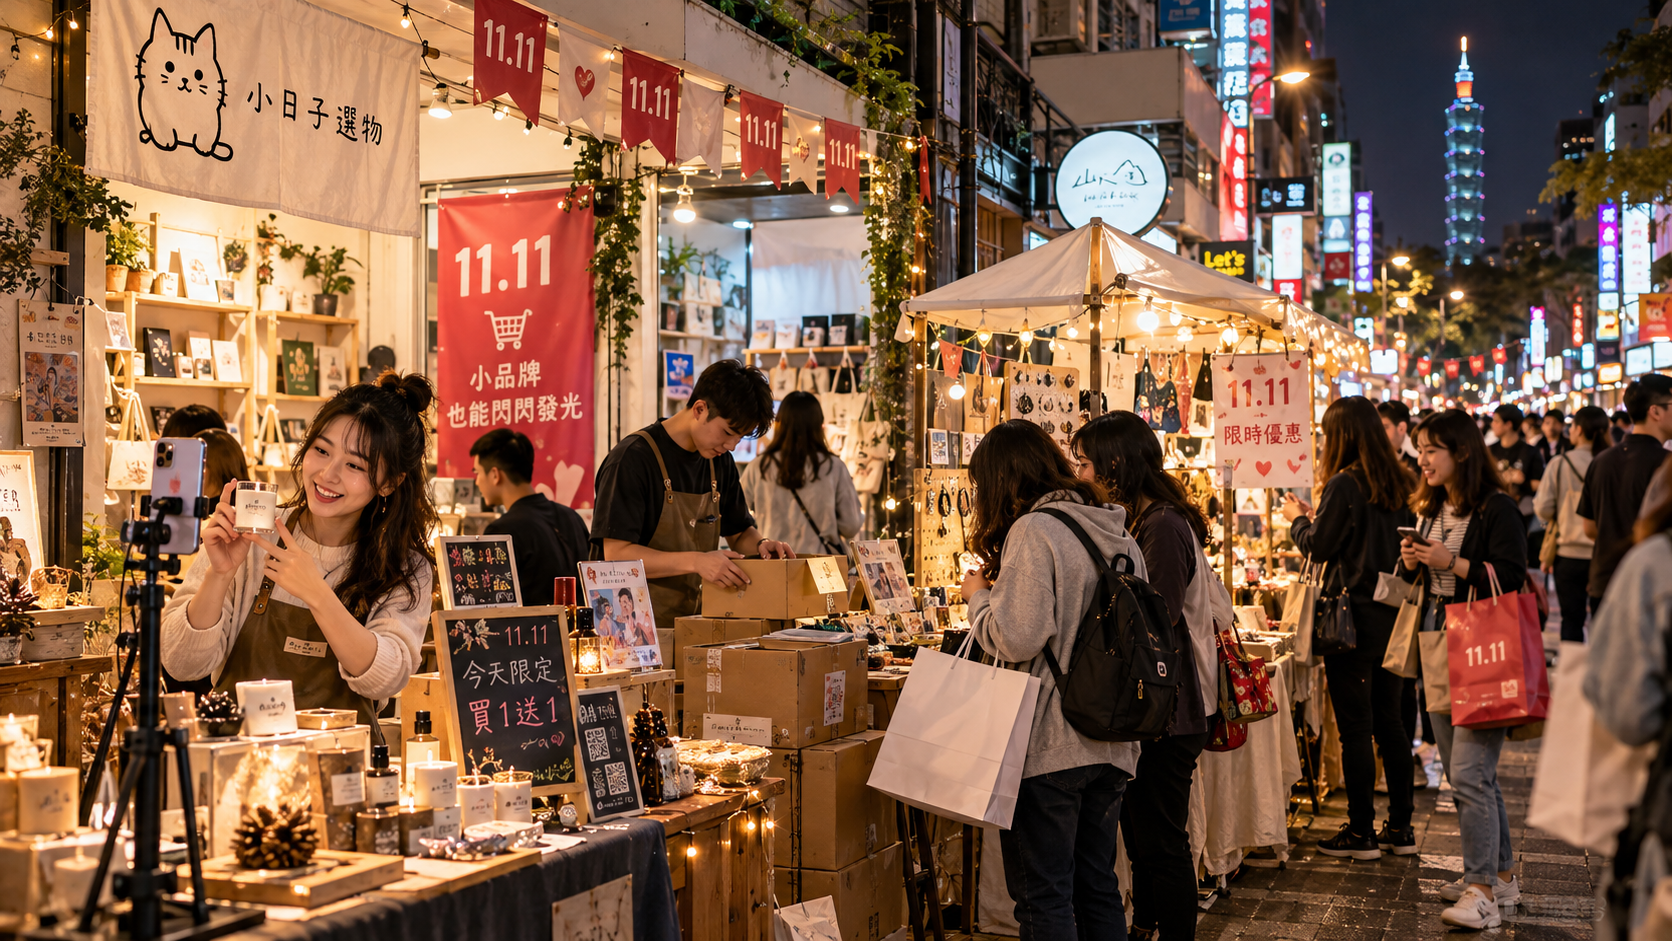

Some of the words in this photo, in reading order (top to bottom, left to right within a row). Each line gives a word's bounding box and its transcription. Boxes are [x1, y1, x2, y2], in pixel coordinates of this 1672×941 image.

[483, 18, 535, 74] 11.11
[247, 82, 382, 146] 小日子選物
[630, 76, 671, 121] 11.11
[745, 113, 778, 151] 11.11
[829, 138, 856, 170] 11.11
[455, 234, 551, 298] 11.11
[1204, 250, 1246, 268] Let's
[470, 359, 541, 392] 小品牌
[1227, 377, 1290, 409] 11.11
[446, 392, 584, 429] 也能閃閃發光
[1224, 422, 1303, 445] 限時優惠
[504, 624, 548, 646] 11.11
[1465, 640, 1506, 667] 11.11
[462, 656, 557, 689] 今天限定
[468, 696, 559, 736] 買1送1
